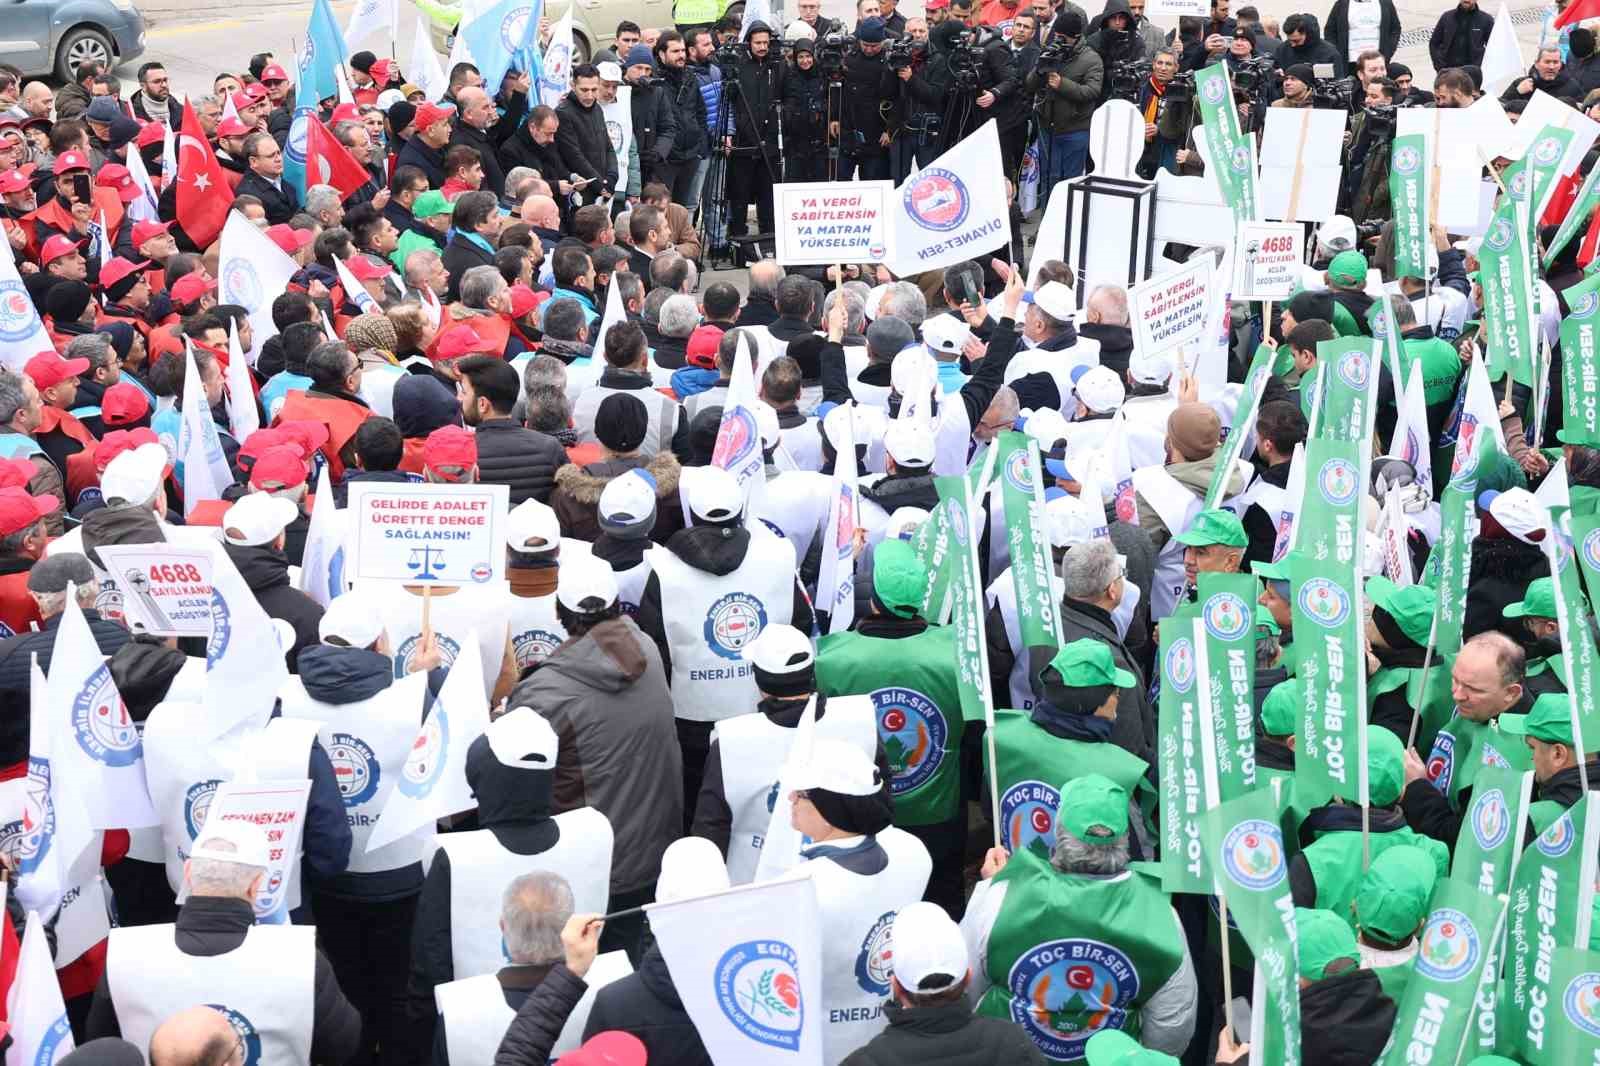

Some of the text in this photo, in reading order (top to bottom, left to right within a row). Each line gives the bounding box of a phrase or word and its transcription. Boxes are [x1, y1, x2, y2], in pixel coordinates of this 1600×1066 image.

[801, 196, 862, 208] YA VERGİ
[791, 209, 877, 222] SABİTLENSİN
[797, 224, 872, 236] YA MATRAH
[799, 235, 871, 248] YÜKSELSİN
[1262, 236, 1294, 253] 4688
[1151, 276, 1195, 304] YA VERGİ
[1143, 285, 1206, 320] SABİTLENSİN
[1150, 300, 1203, 332] YA MATRAH
[1152, 312, 1202, 344] YÜKSELSİN
[371, 498, 488, 511] GELİRDE ADALET
[372, 512, 486, 526] ÜCRETTE DENGE
[385, 527, 472, 541] SAĞLANSIN!
[150, 563, 202, 583] 4688
[690, 665, 735, 682] ENERJİ
[882, 691, 937, 719] BİR-SEN
[1007, 787, 1031, 809] TOÇ
[275, 811, 296, 824] ZAM
[61, 885, 81, 910] SEN
[1029, 944, 1131, 982] TOÇ BİR-SEN
[830, 1003, 882, 1023] ENERJİ
